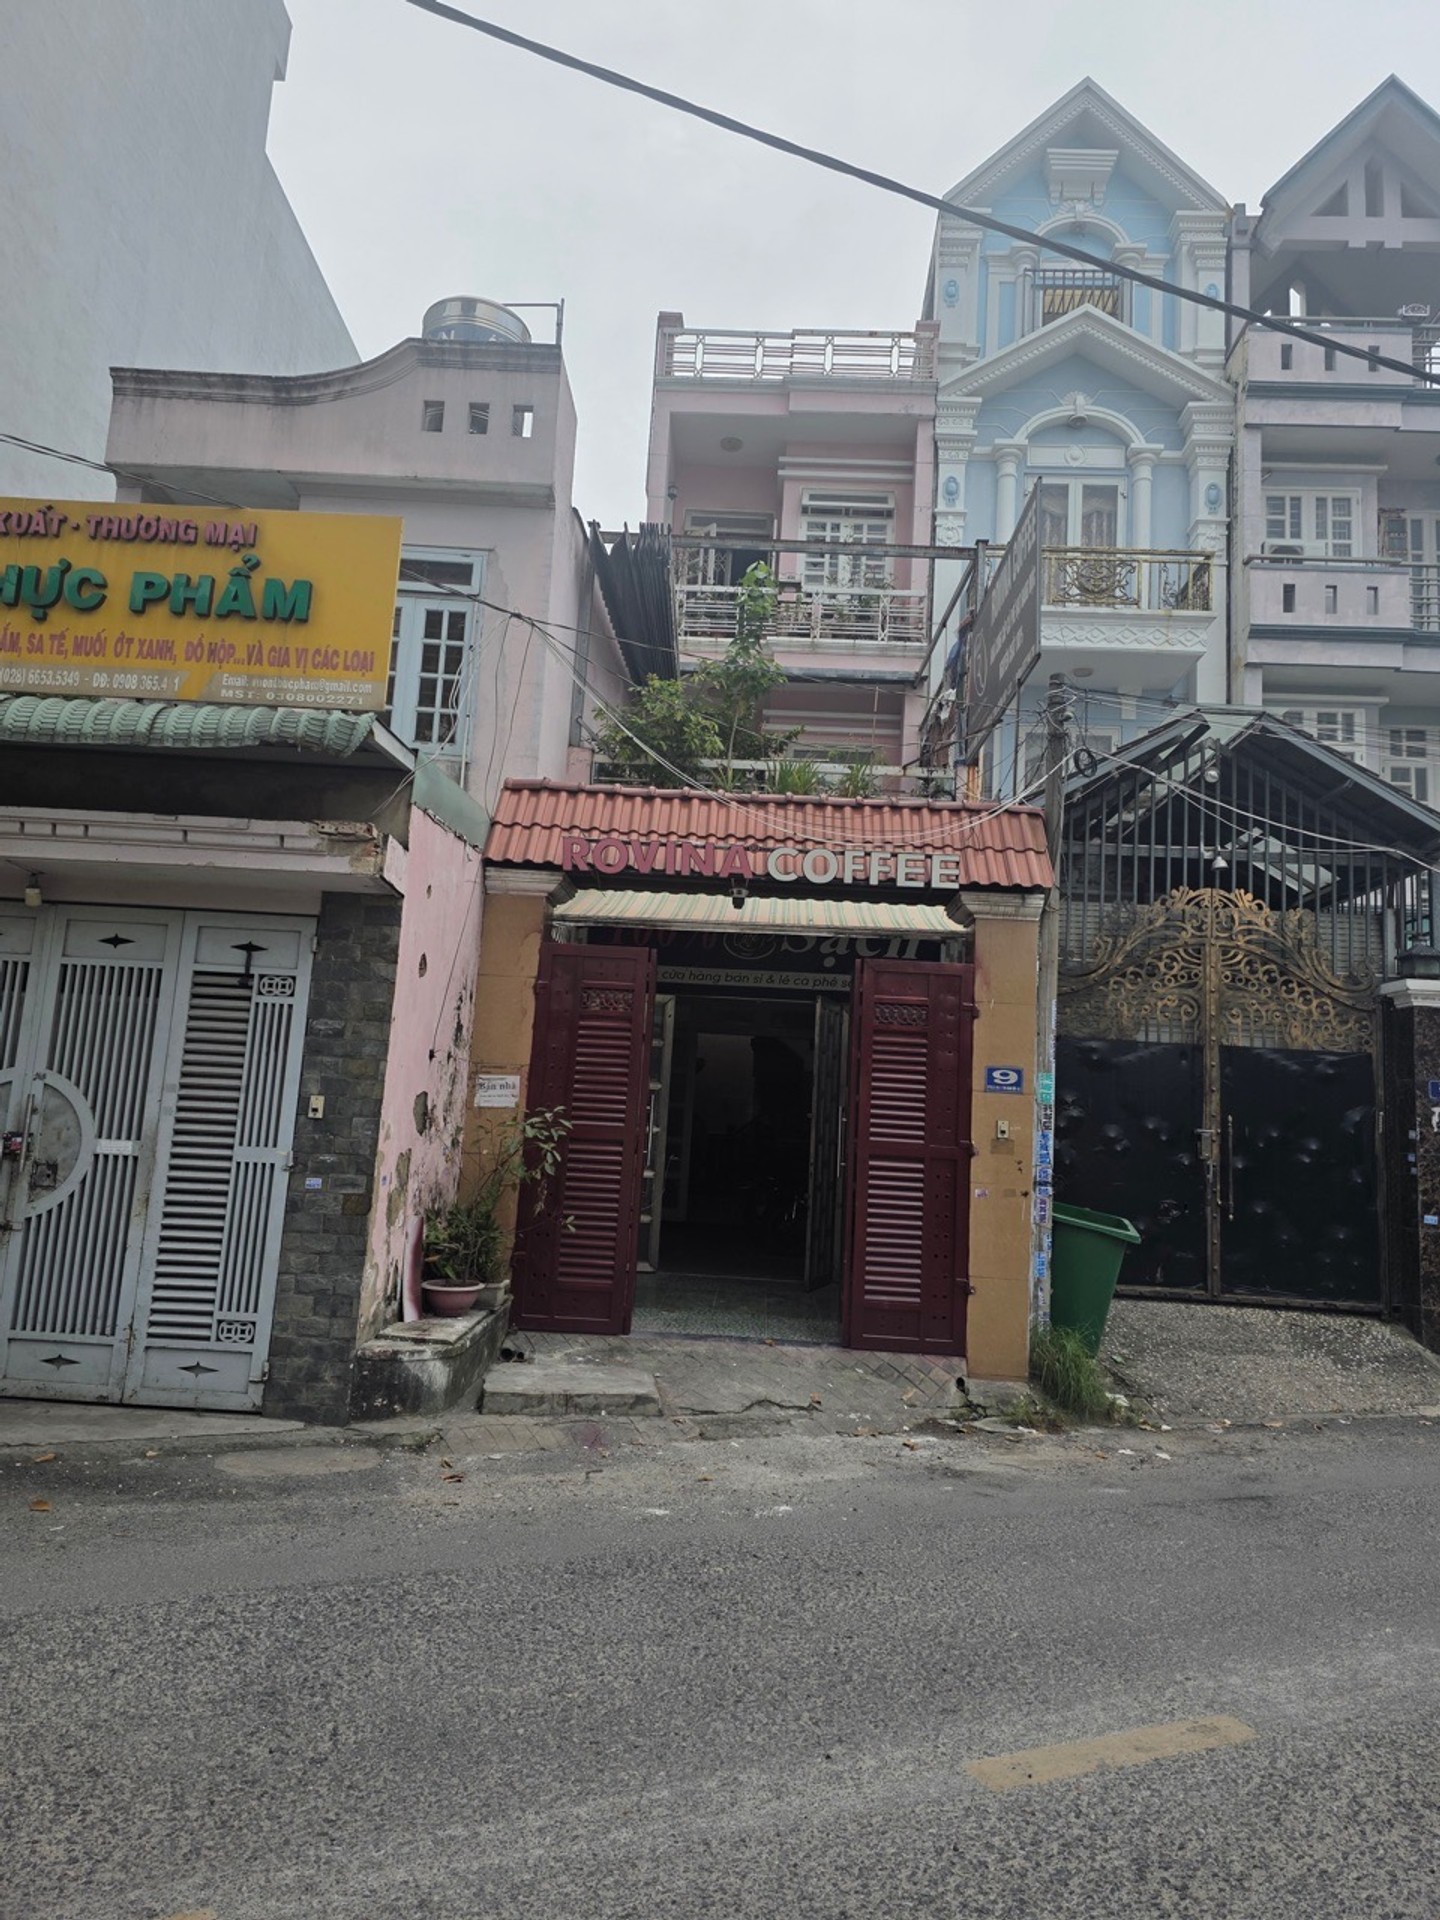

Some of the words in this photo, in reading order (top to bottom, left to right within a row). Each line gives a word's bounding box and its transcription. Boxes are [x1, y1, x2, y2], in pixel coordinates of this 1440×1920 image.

[87, 512, 197, 544] THƯƠNG
[204, 520, 257, 553] MẠI
[129, 553, 312, 622] PHẨM
[27, 632, 44, 656] SA
[136, 638, 177, 665] XANH,
[267, 645, 290, 668] GIA
[312, 644, 340, 671] CÁC
[343, 650, 375, 677] LOẠI
[140, 675, 180, 692] 365.41
[562, 837, 753, 879] ROVINA
[767, 847, 960, 889] COFFEE
[992, 1069, 1018, 1085] 9
